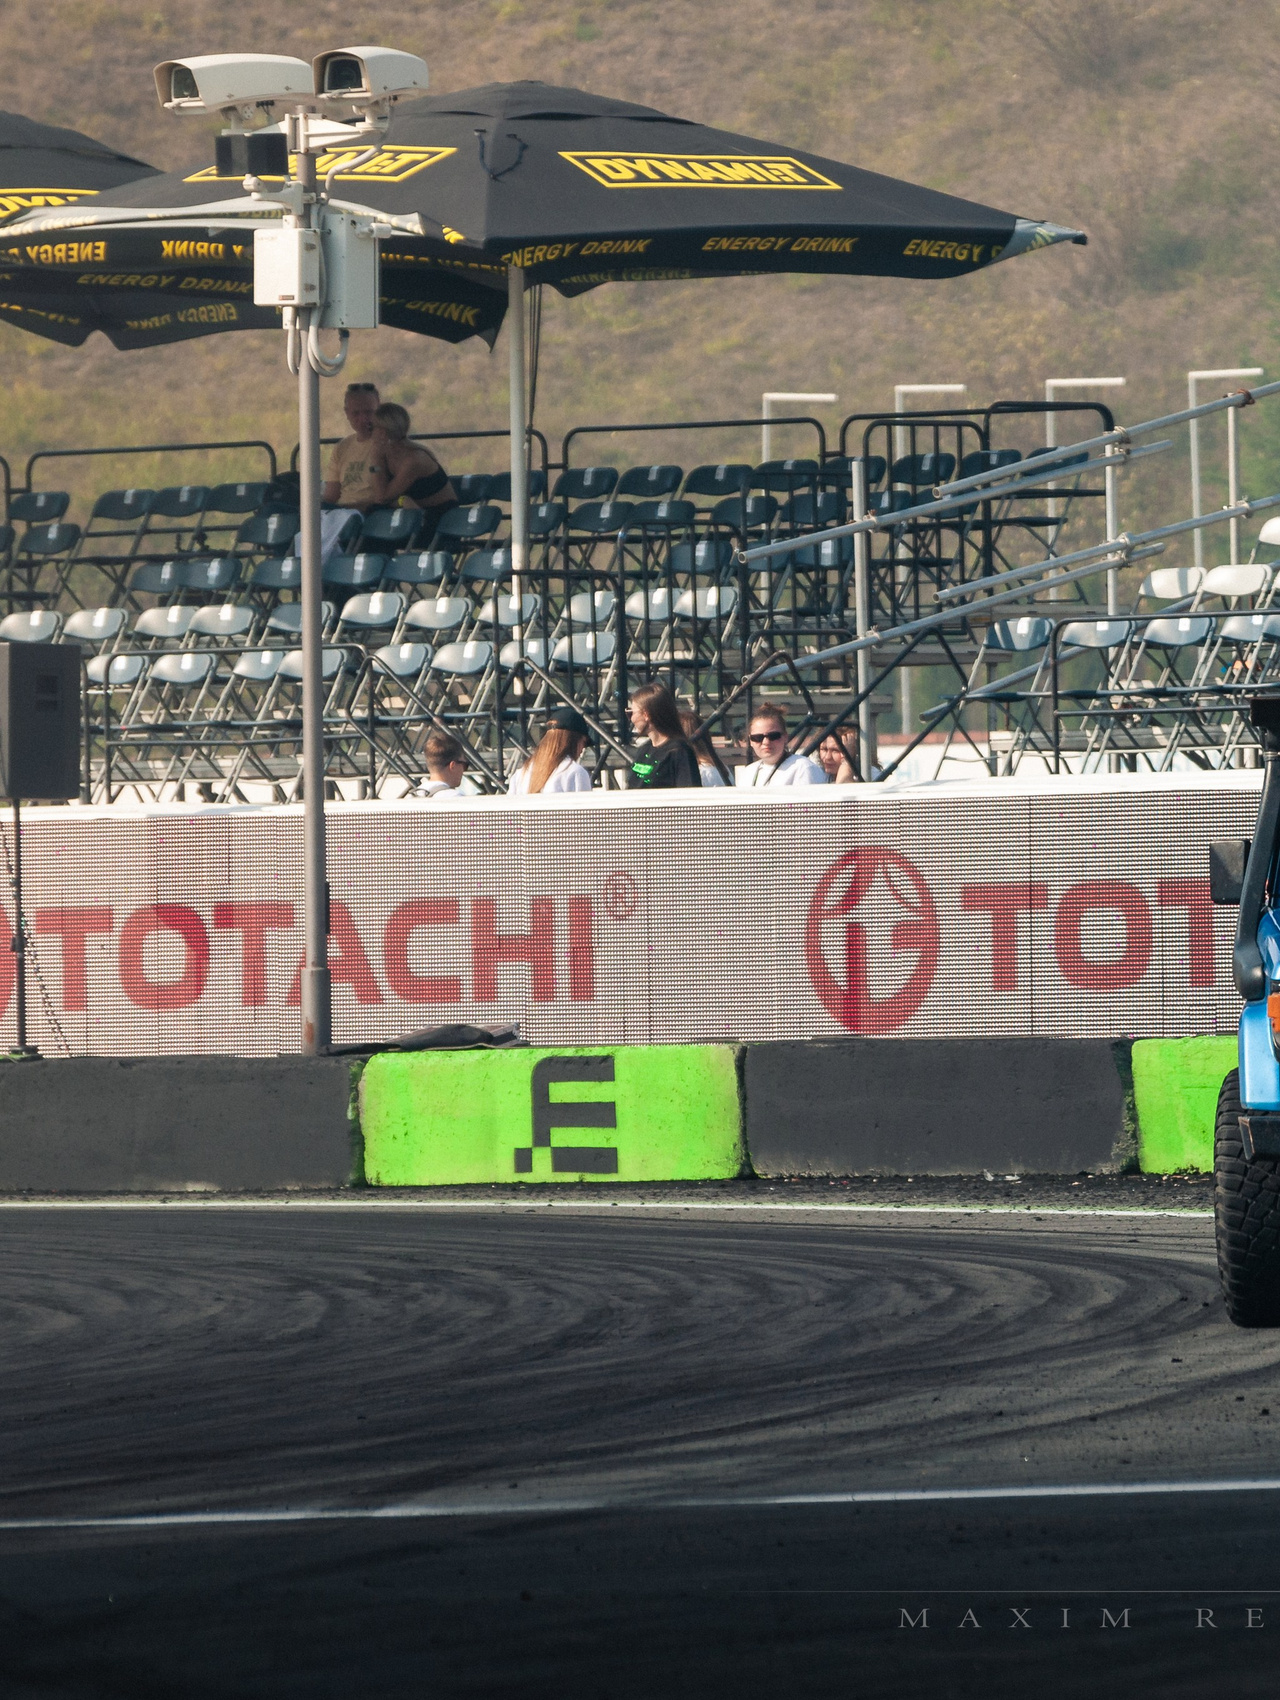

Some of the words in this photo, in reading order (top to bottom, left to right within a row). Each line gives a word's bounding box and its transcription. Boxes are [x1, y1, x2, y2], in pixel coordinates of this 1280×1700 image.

[501, 243, 579, 268] ENERGY
[580, 239, 652, 255] DRINK
[702, 237, 790, 251] ENERGY
[790, 237, 859, 253] DRINK
[903, 239, 983, 262] ENERGY
[77, 273, 175, 288] ENERGY
[178, 277, 253, 293] DRINK
